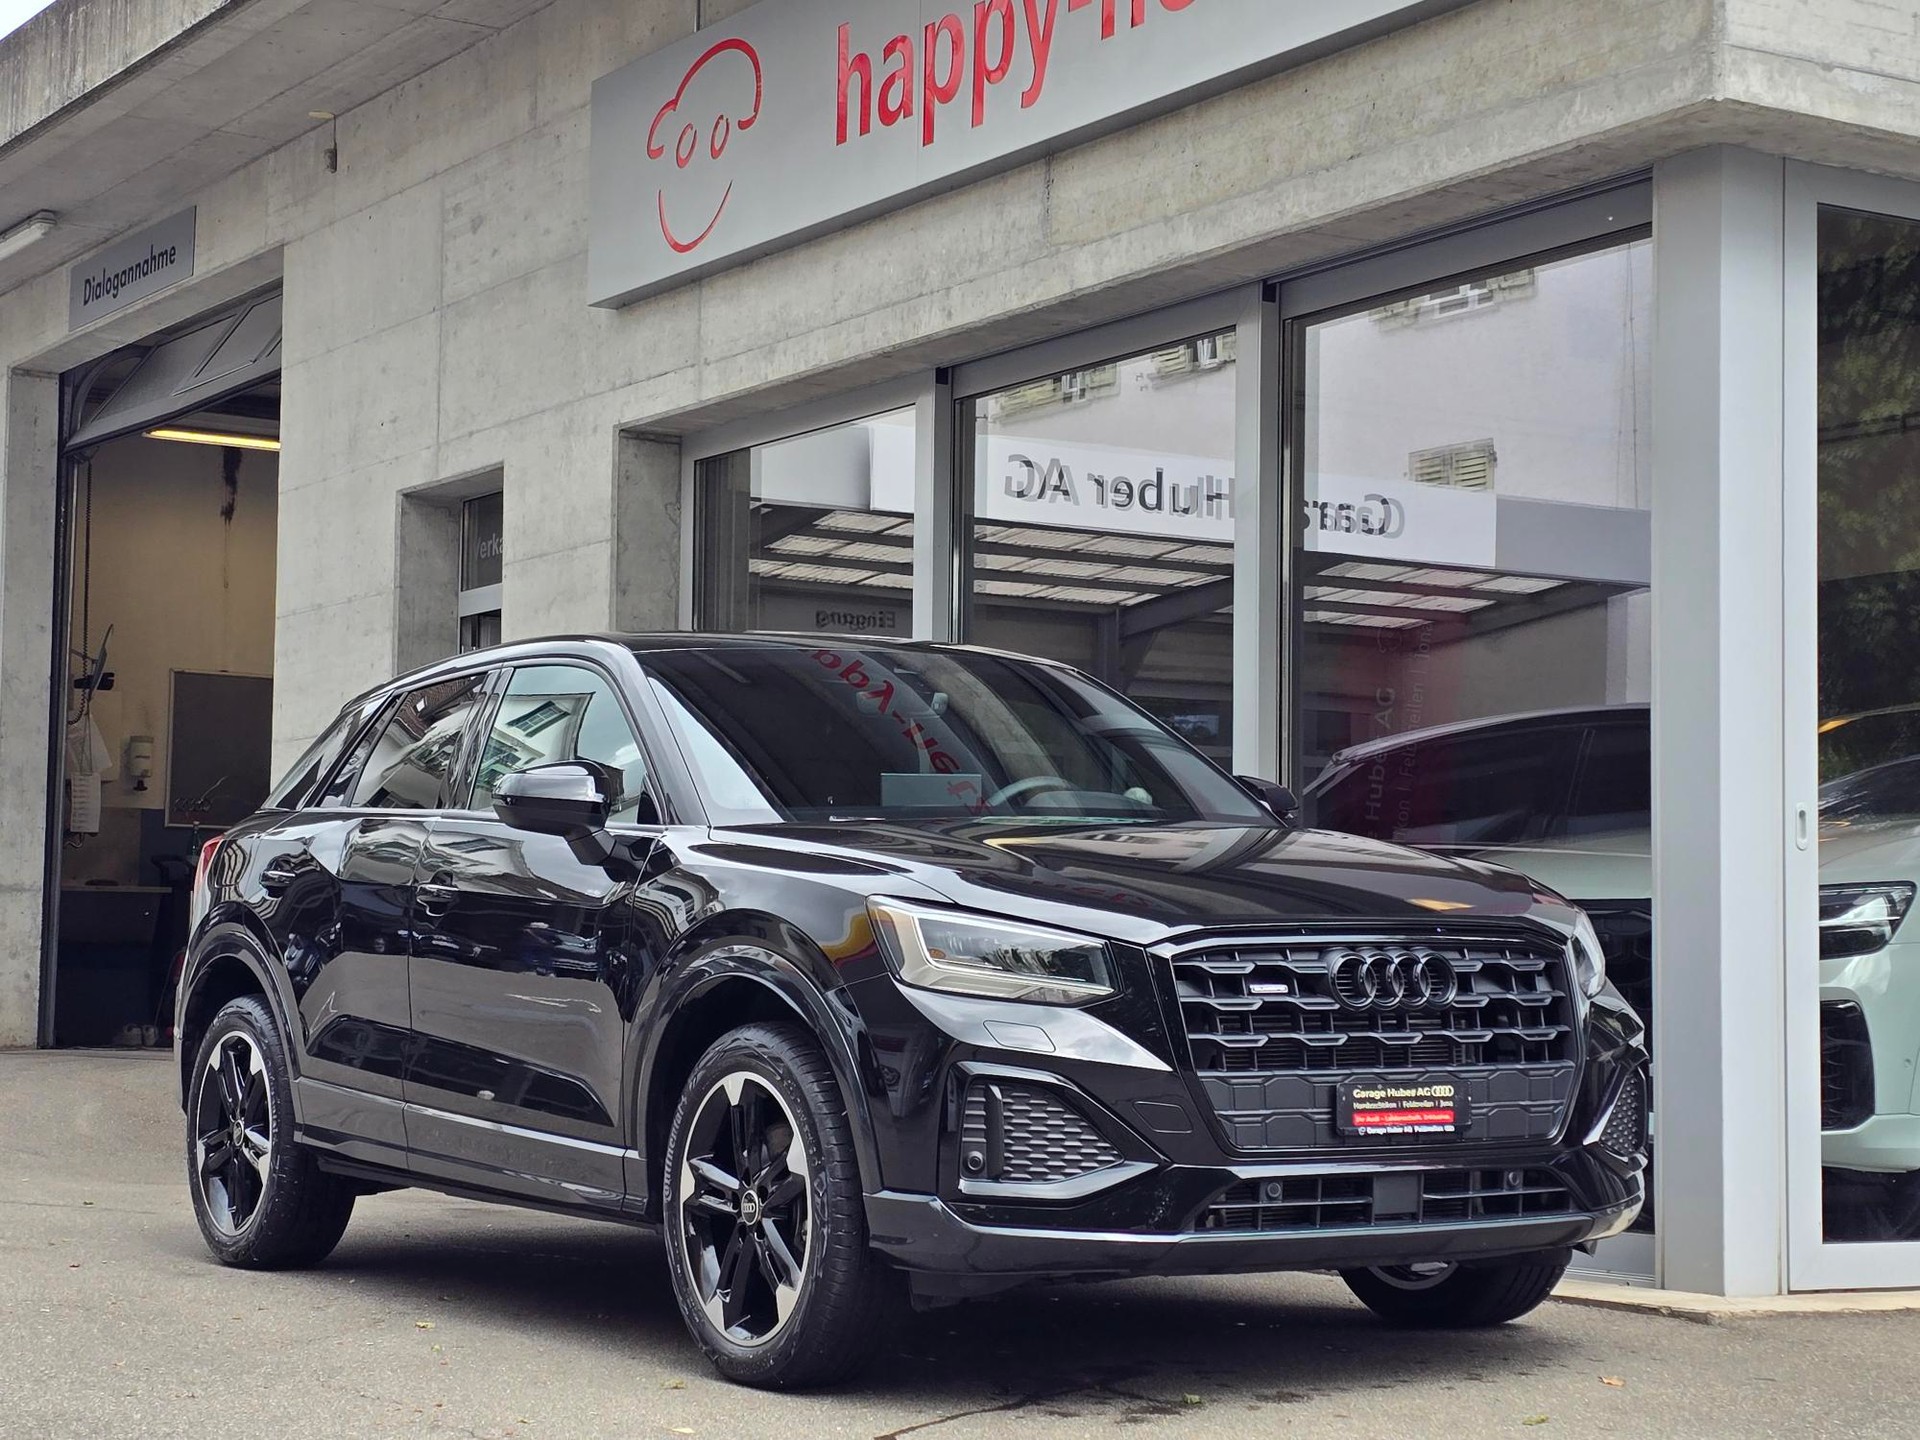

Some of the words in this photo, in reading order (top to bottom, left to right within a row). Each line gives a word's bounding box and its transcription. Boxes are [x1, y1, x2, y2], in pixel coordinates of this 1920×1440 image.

[83, 244, 176, 306] Dialogannahme
[1374, 687, 1396, 730] AG
[1366, 748, 1388, 820] Hube
[1353, 1089, 1386, 1099] Garage
[1417, 1087, 1431, 1096] AG
[663, 1104, 684, 1203] Continental
